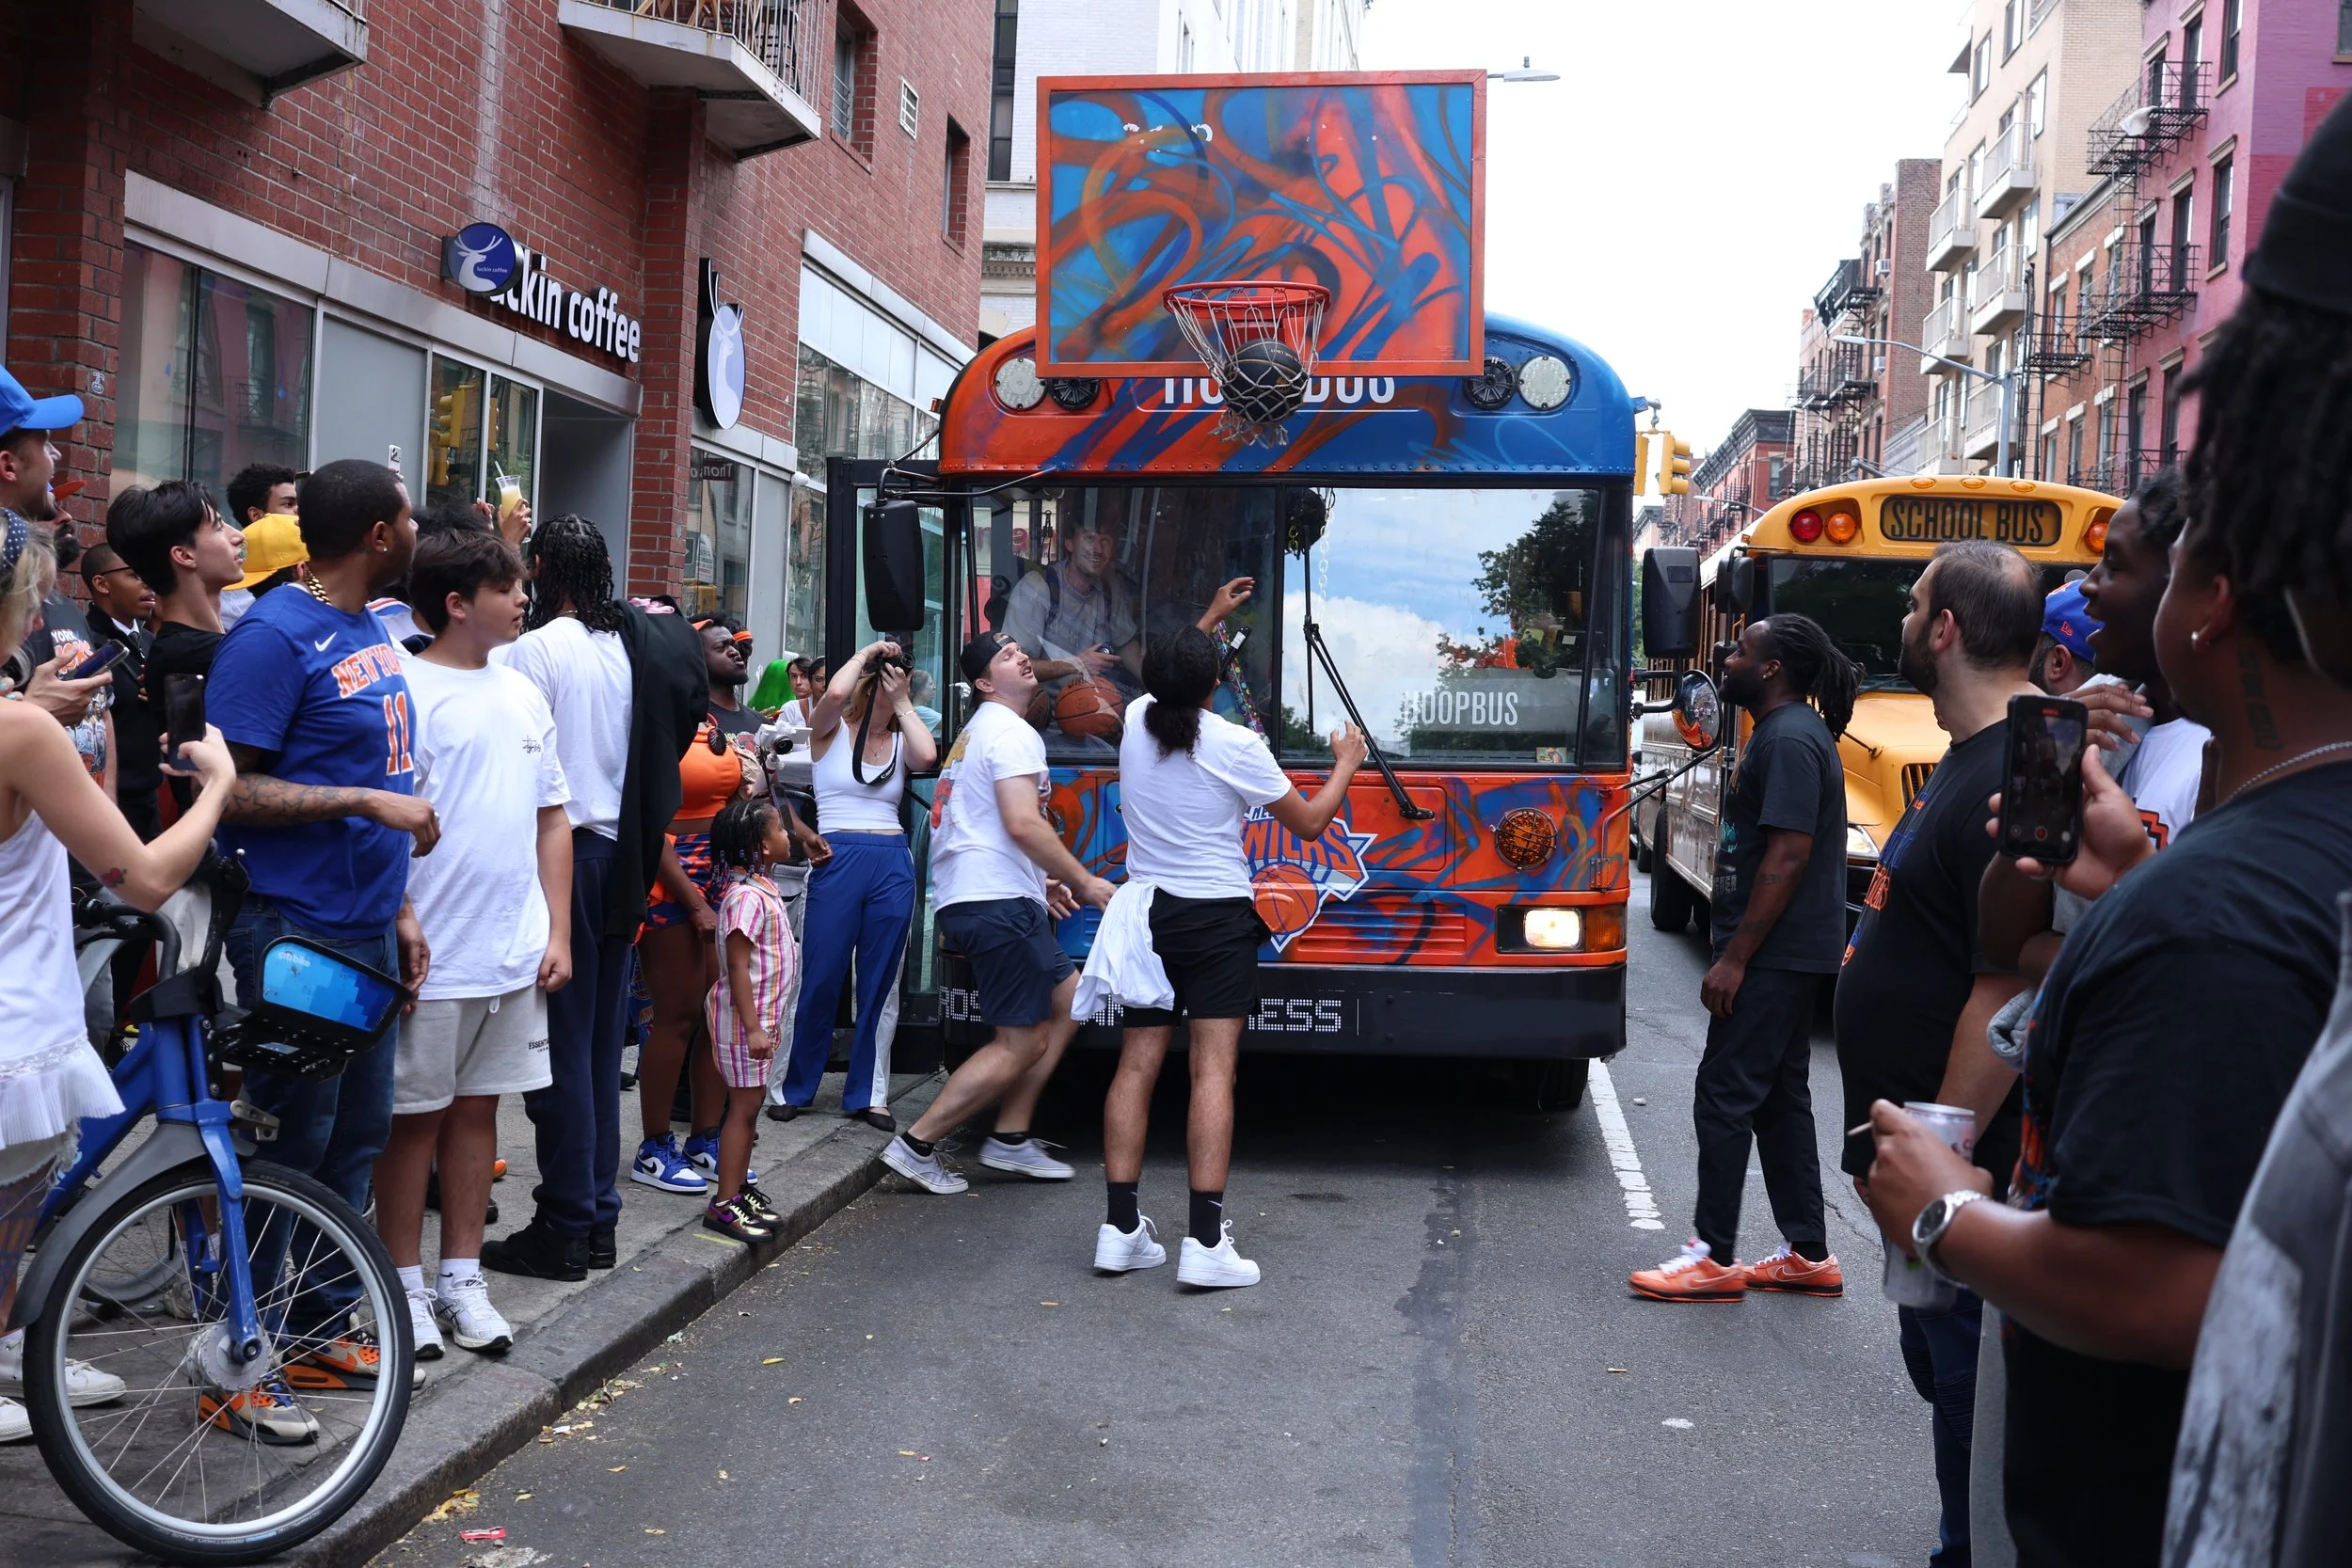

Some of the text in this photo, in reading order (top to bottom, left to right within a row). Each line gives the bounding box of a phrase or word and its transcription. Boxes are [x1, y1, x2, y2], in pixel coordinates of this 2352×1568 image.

[568, 286, 640, 363] coffee
[1891, 499, 2043, 543] SCHOOL BUS
[331, 647, 380, 699] NEW
[1407, 690, 1518, 726] HOOPBUS
[383, 690, 414, 776] 11
[278, 950, 311, 968] citi bike
